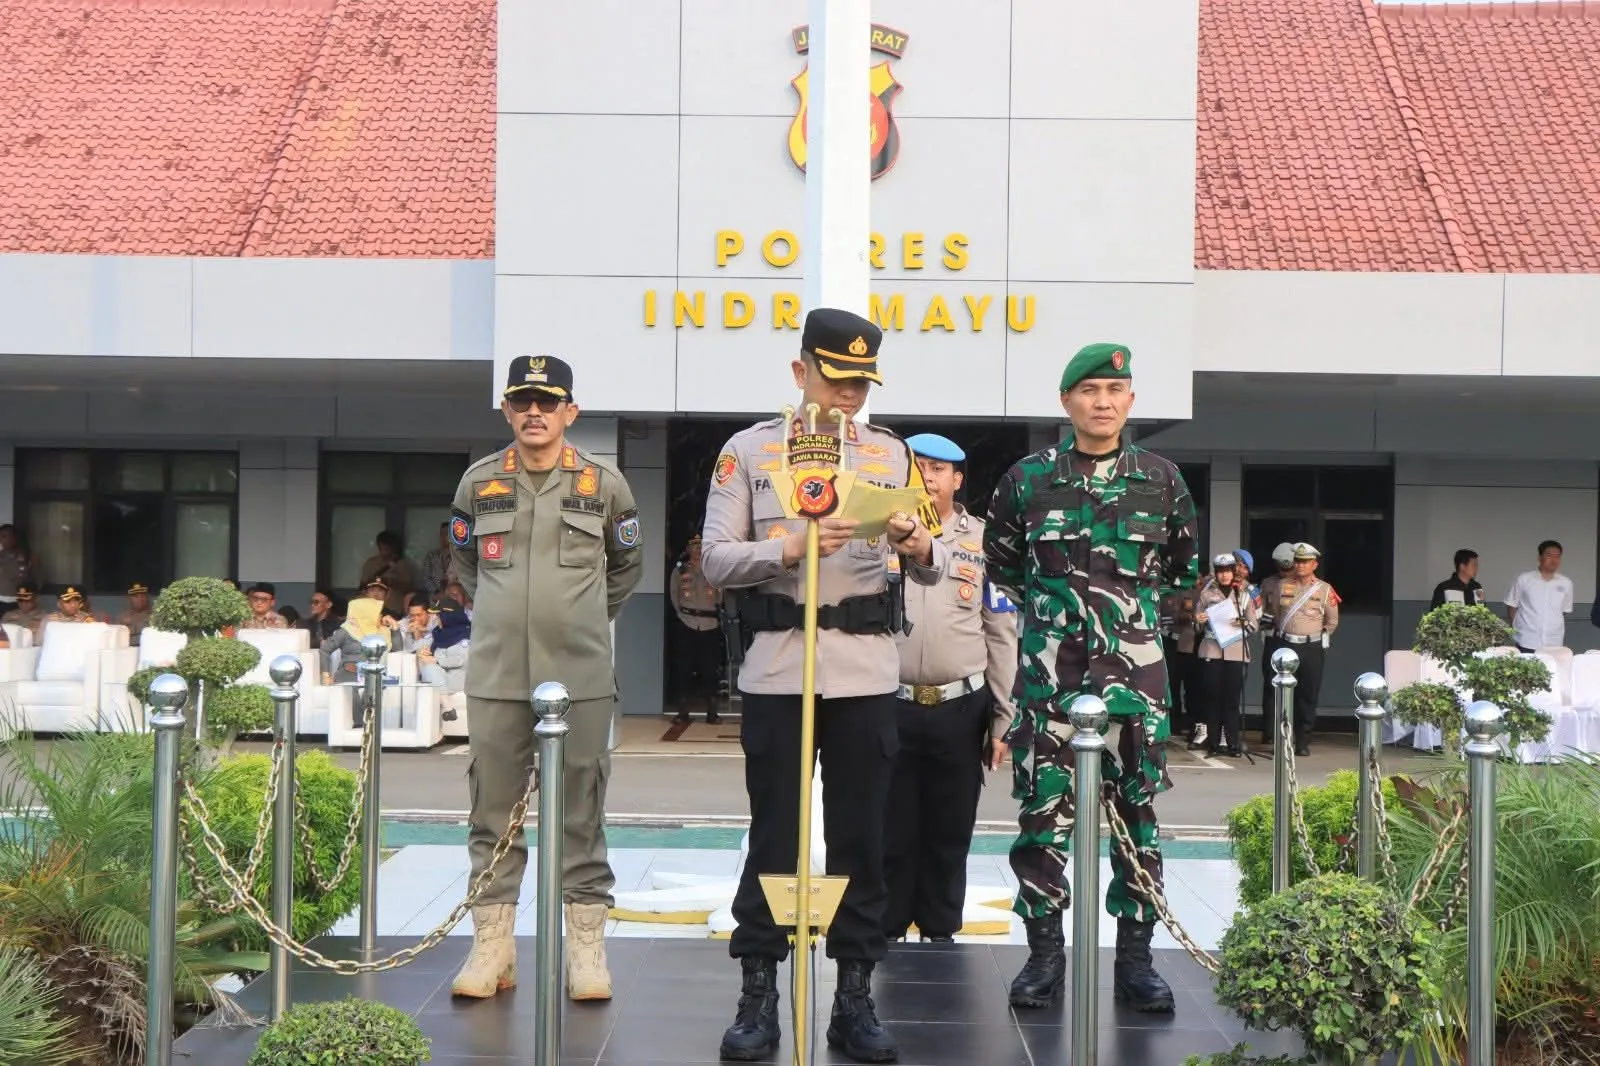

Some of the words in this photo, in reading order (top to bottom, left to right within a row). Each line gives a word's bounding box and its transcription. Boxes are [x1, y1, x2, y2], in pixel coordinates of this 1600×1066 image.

[717, 231, 969, 270] PORES
[644, 290, 1036, 332] INDRMAYU
[796, 435, 834, 444] POLRES
[791, 442, 838, 451] INDRAMAYU
[791, 453, 812, 463] JAWA
[813, 453, 838, 463] BARAT
[952, 551, 985, 567] POLRI
